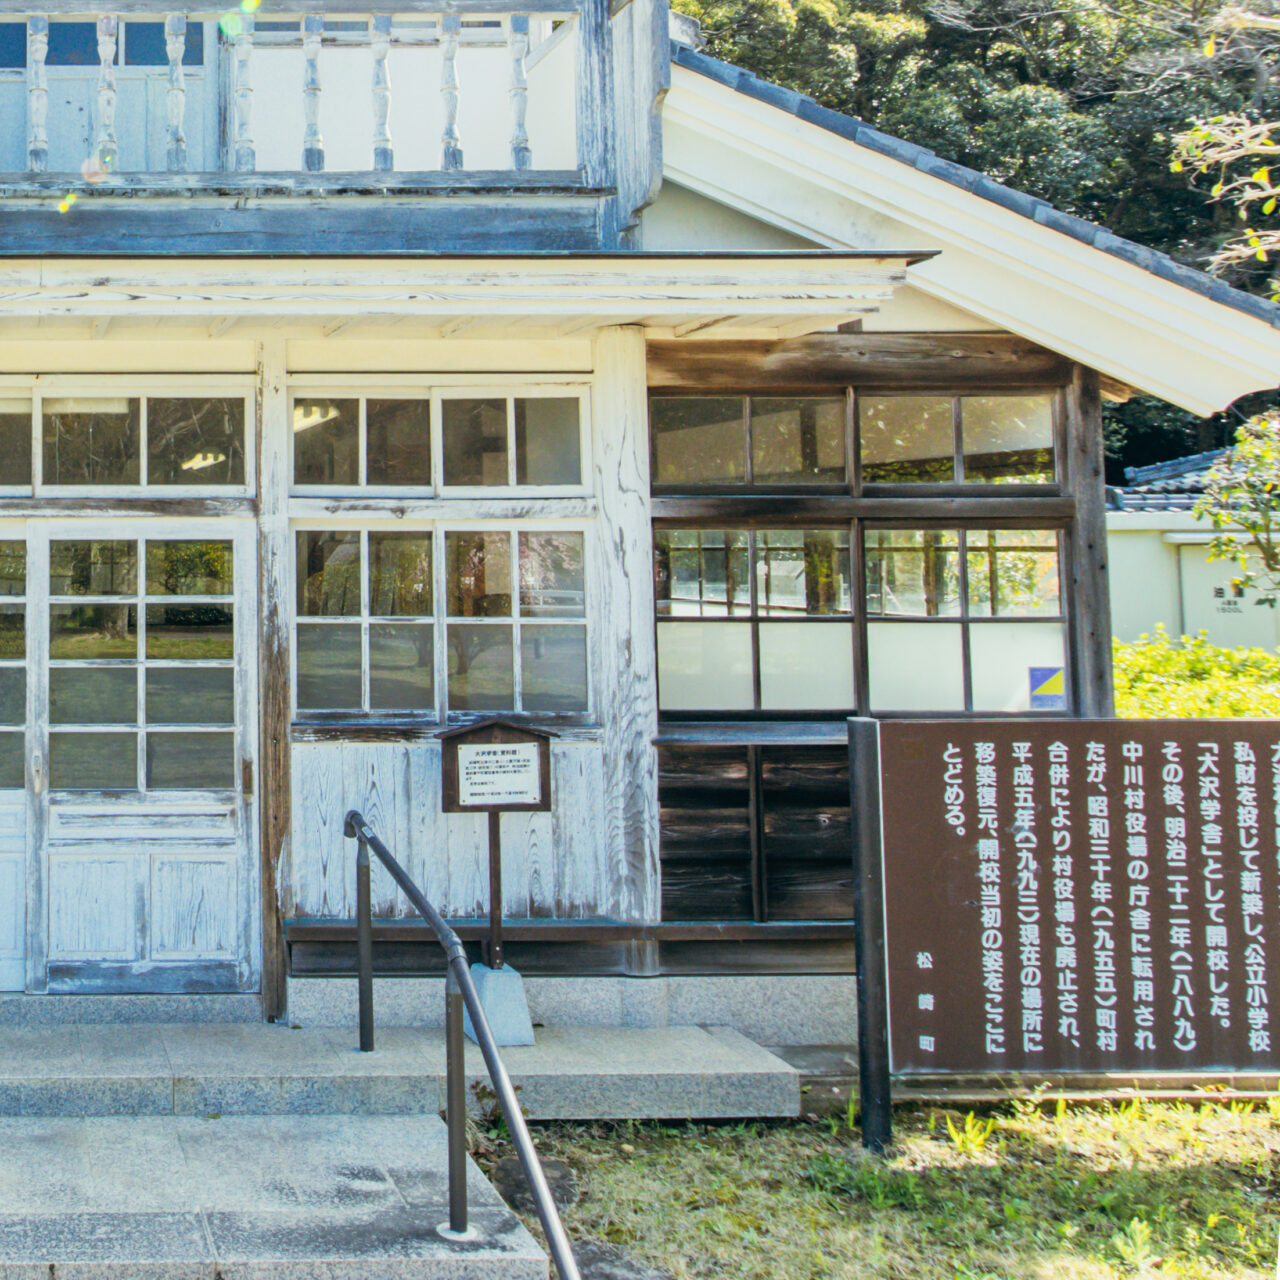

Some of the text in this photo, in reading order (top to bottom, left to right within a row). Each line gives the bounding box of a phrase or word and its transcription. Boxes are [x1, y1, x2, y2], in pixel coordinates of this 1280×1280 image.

[942, 742, 966, 836] とどめる。
[974, 742, 1006, 1055] 移築復元、開校当初の姿をここに
[1122, 740, 1157, 1051] 中川村役場の庁舎に転用され
